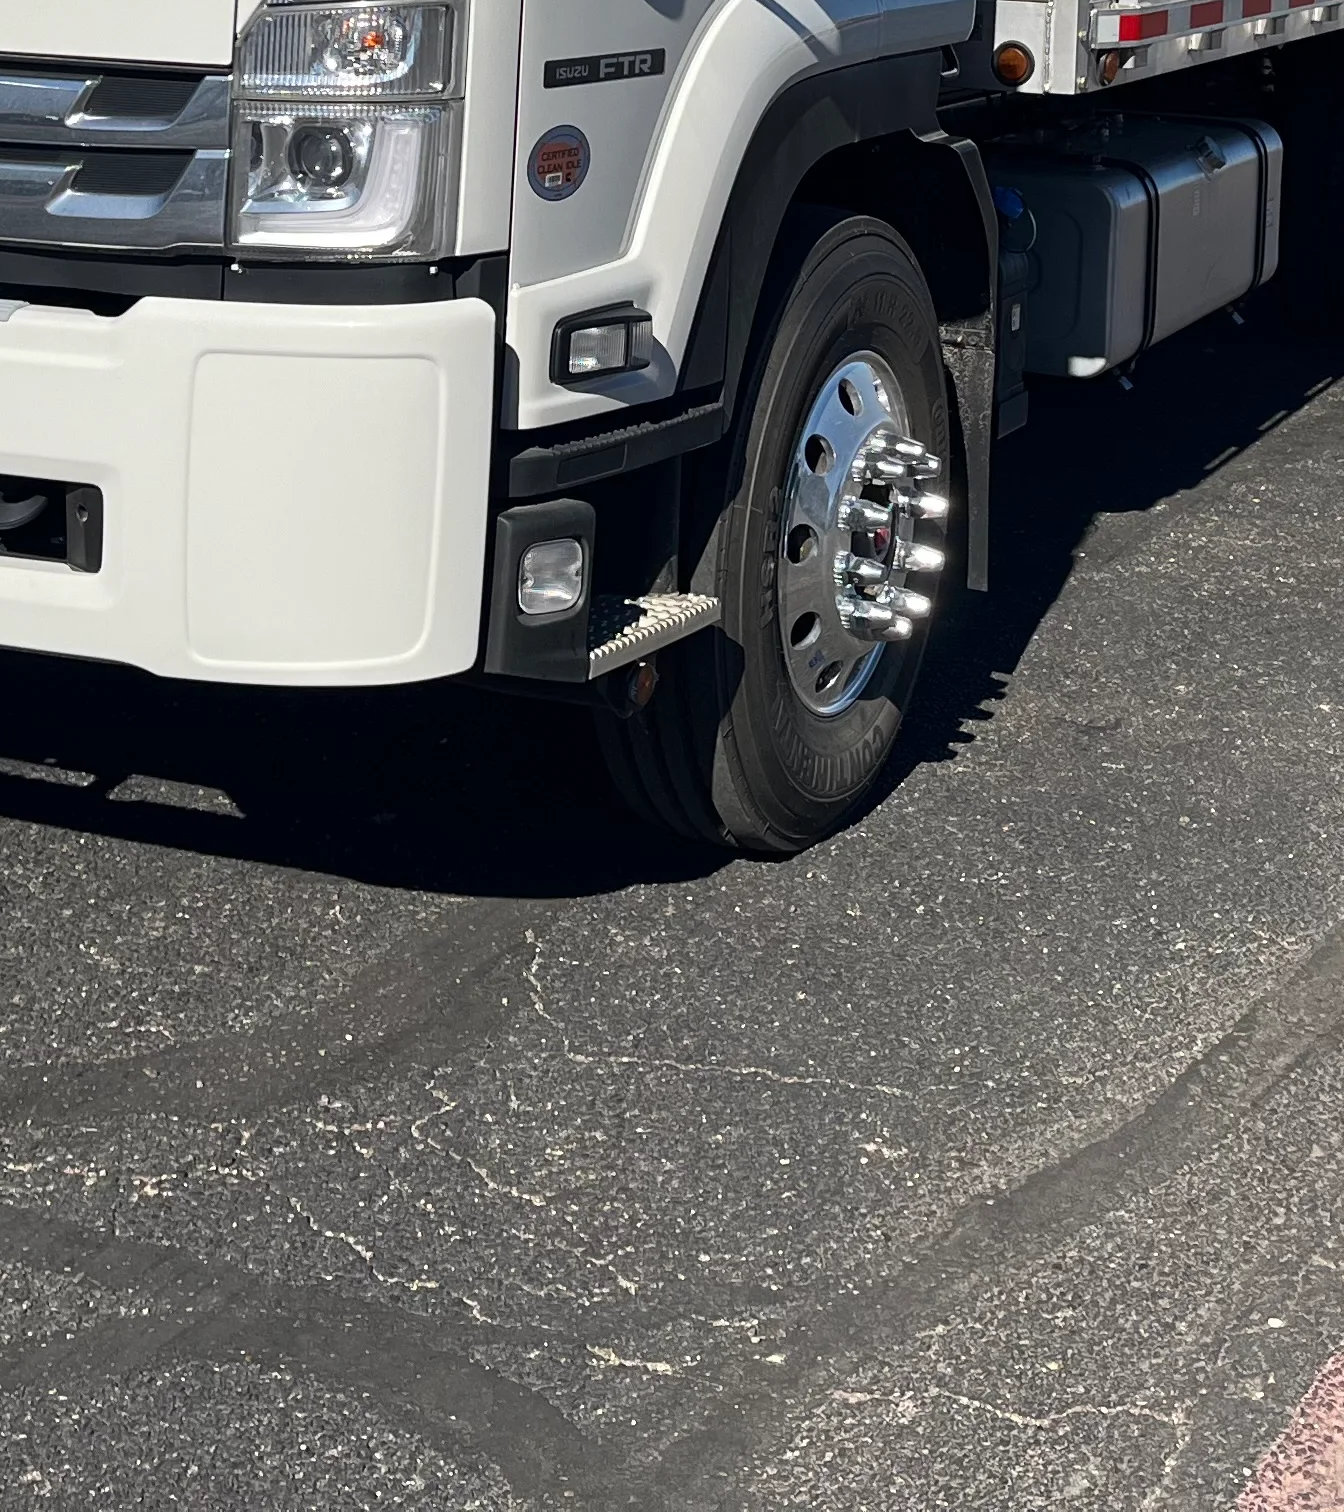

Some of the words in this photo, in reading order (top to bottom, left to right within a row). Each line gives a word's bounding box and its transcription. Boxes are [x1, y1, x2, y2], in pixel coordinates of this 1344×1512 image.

[556, 64, 589, 80] ISUZU
[599, 54, 653, 78] FTR
[541, 147, 580, 162] CERTIFIED
[537, 162, 563, 175] CLEAN
[565, 158, 582, 170] IDLE
